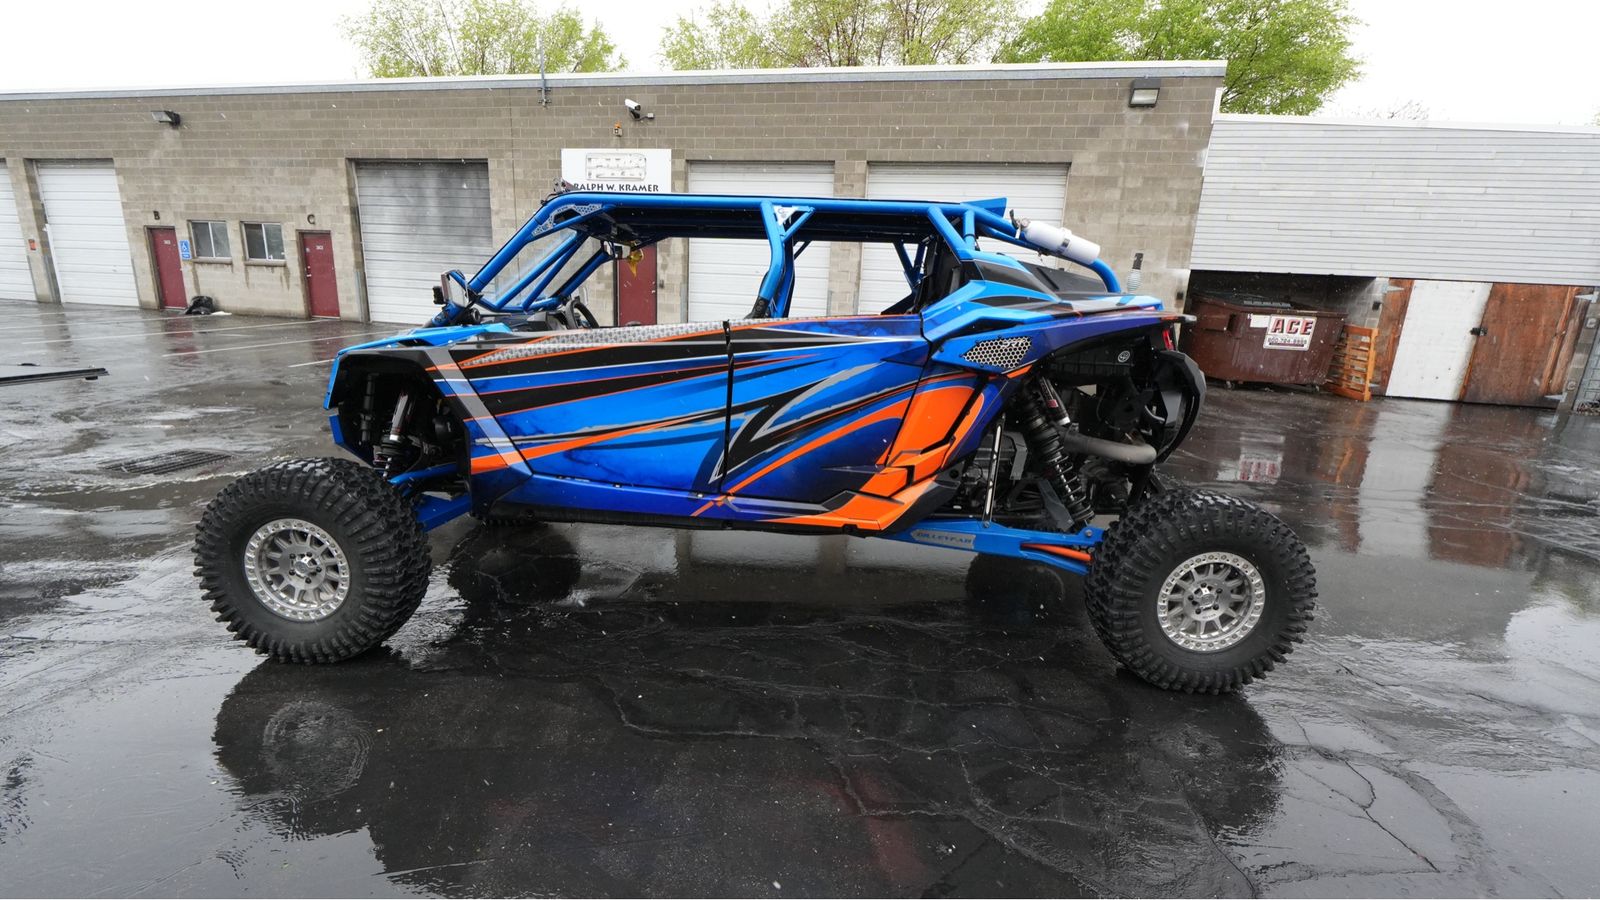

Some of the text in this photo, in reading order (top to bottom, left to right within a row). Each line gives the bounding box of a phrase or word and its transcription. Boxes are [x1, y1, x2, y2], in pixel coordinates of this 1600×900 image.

[574, 183, 659, 192] RALPH W. KRAMER
[153, 211, 160, 220] B
[307, 214, 315, 224] C
[1271, 318, 1313, 335] ACE
